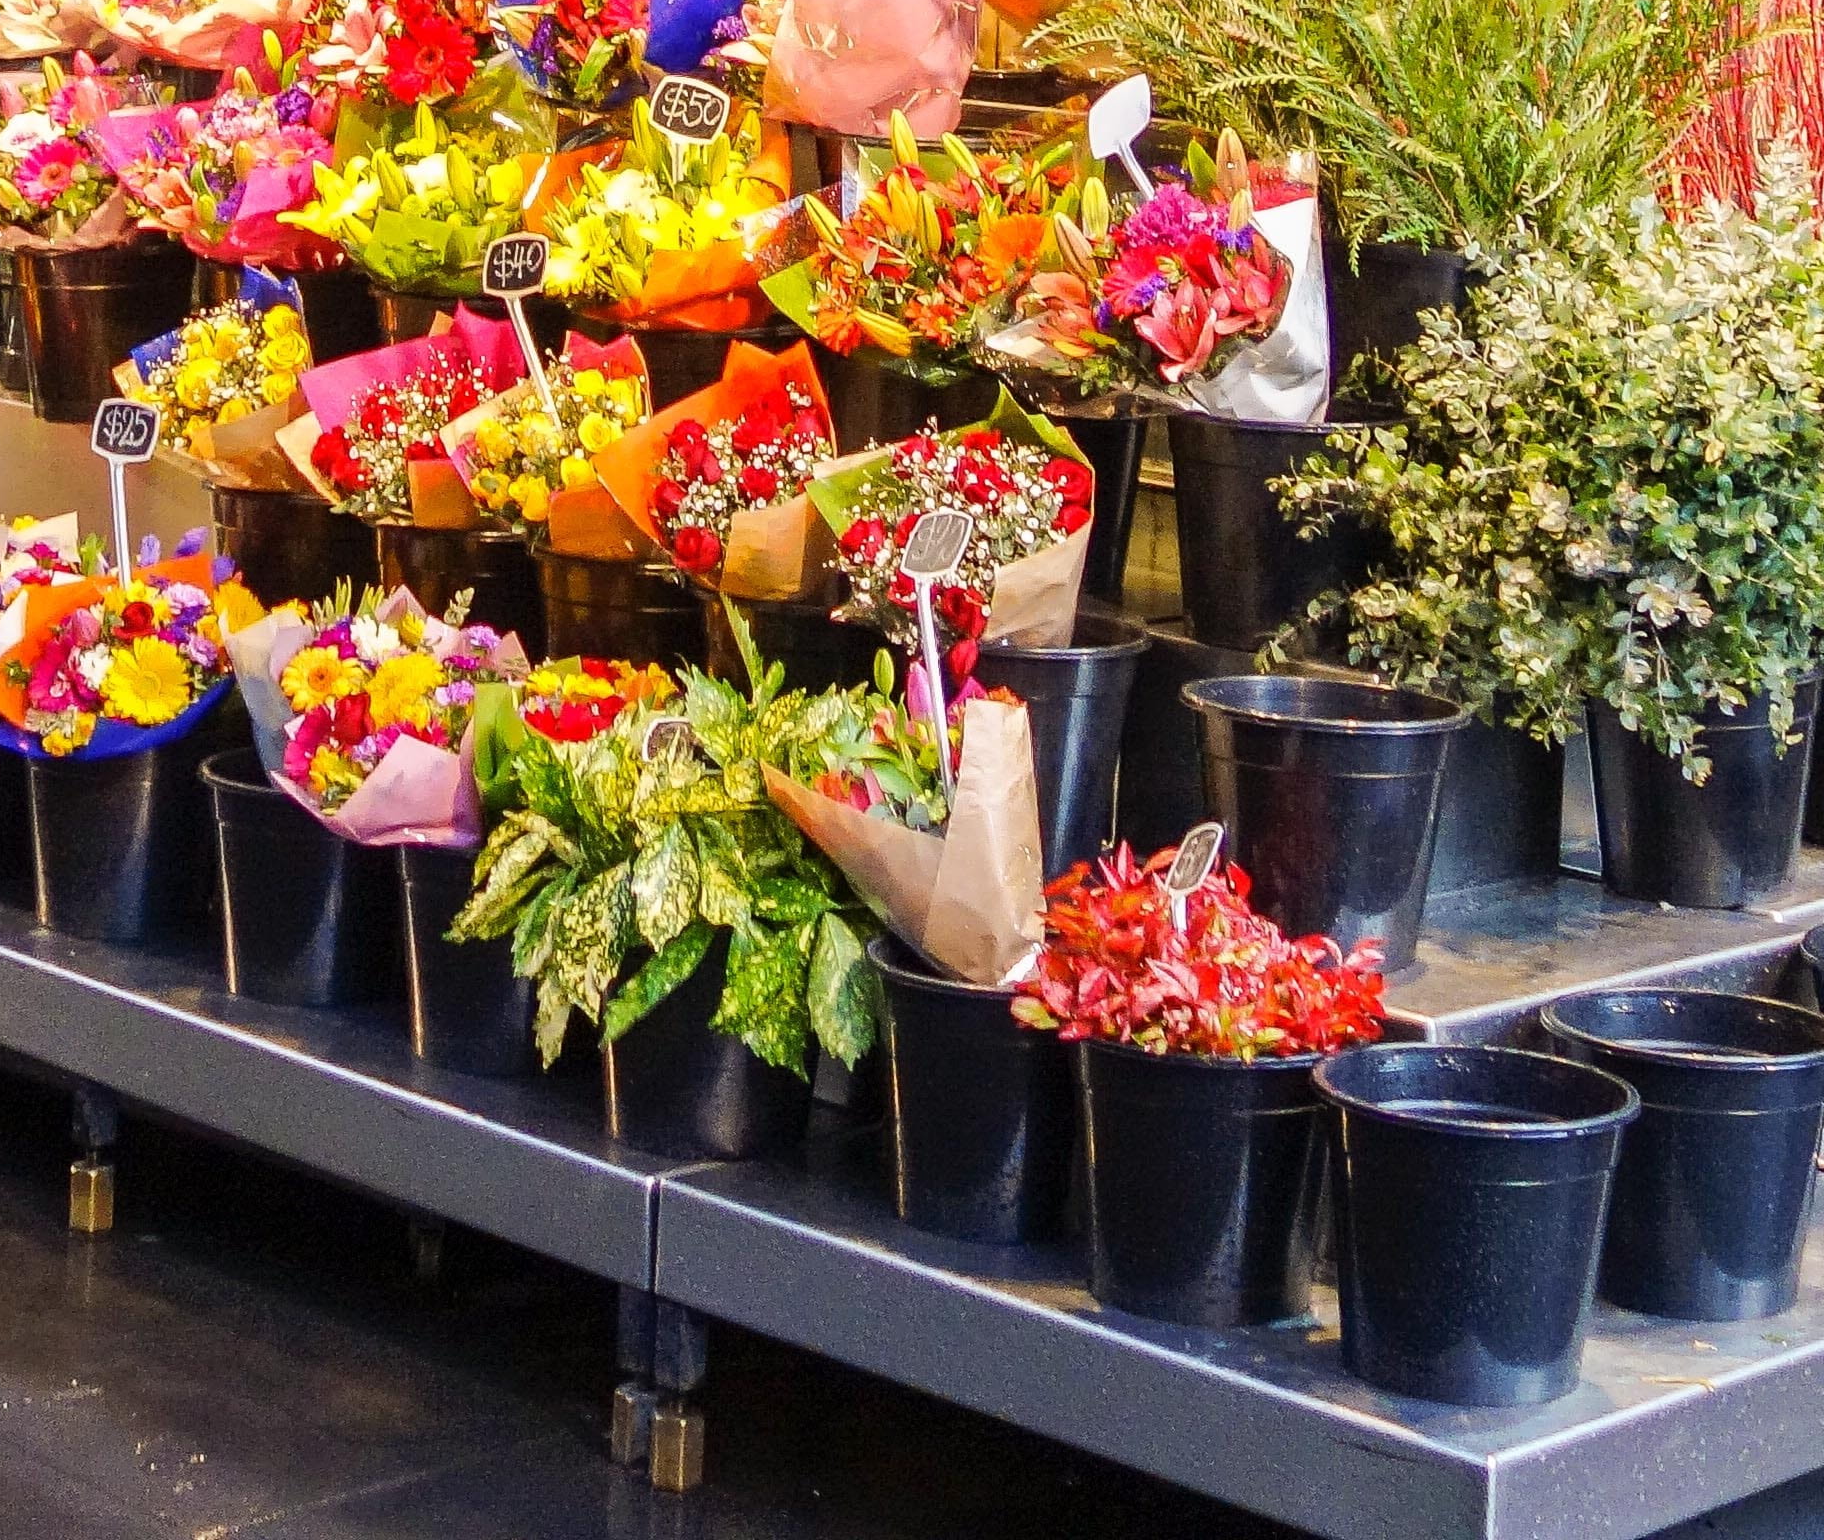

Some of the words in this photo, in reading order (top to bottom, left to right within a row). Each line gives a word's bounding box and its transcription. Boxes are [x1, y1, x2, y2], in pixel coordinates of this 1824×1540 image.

[661, 82, 723, 128] $50
[493, 242, 544, 288] $40
[103, 405, 153, 448] $25
